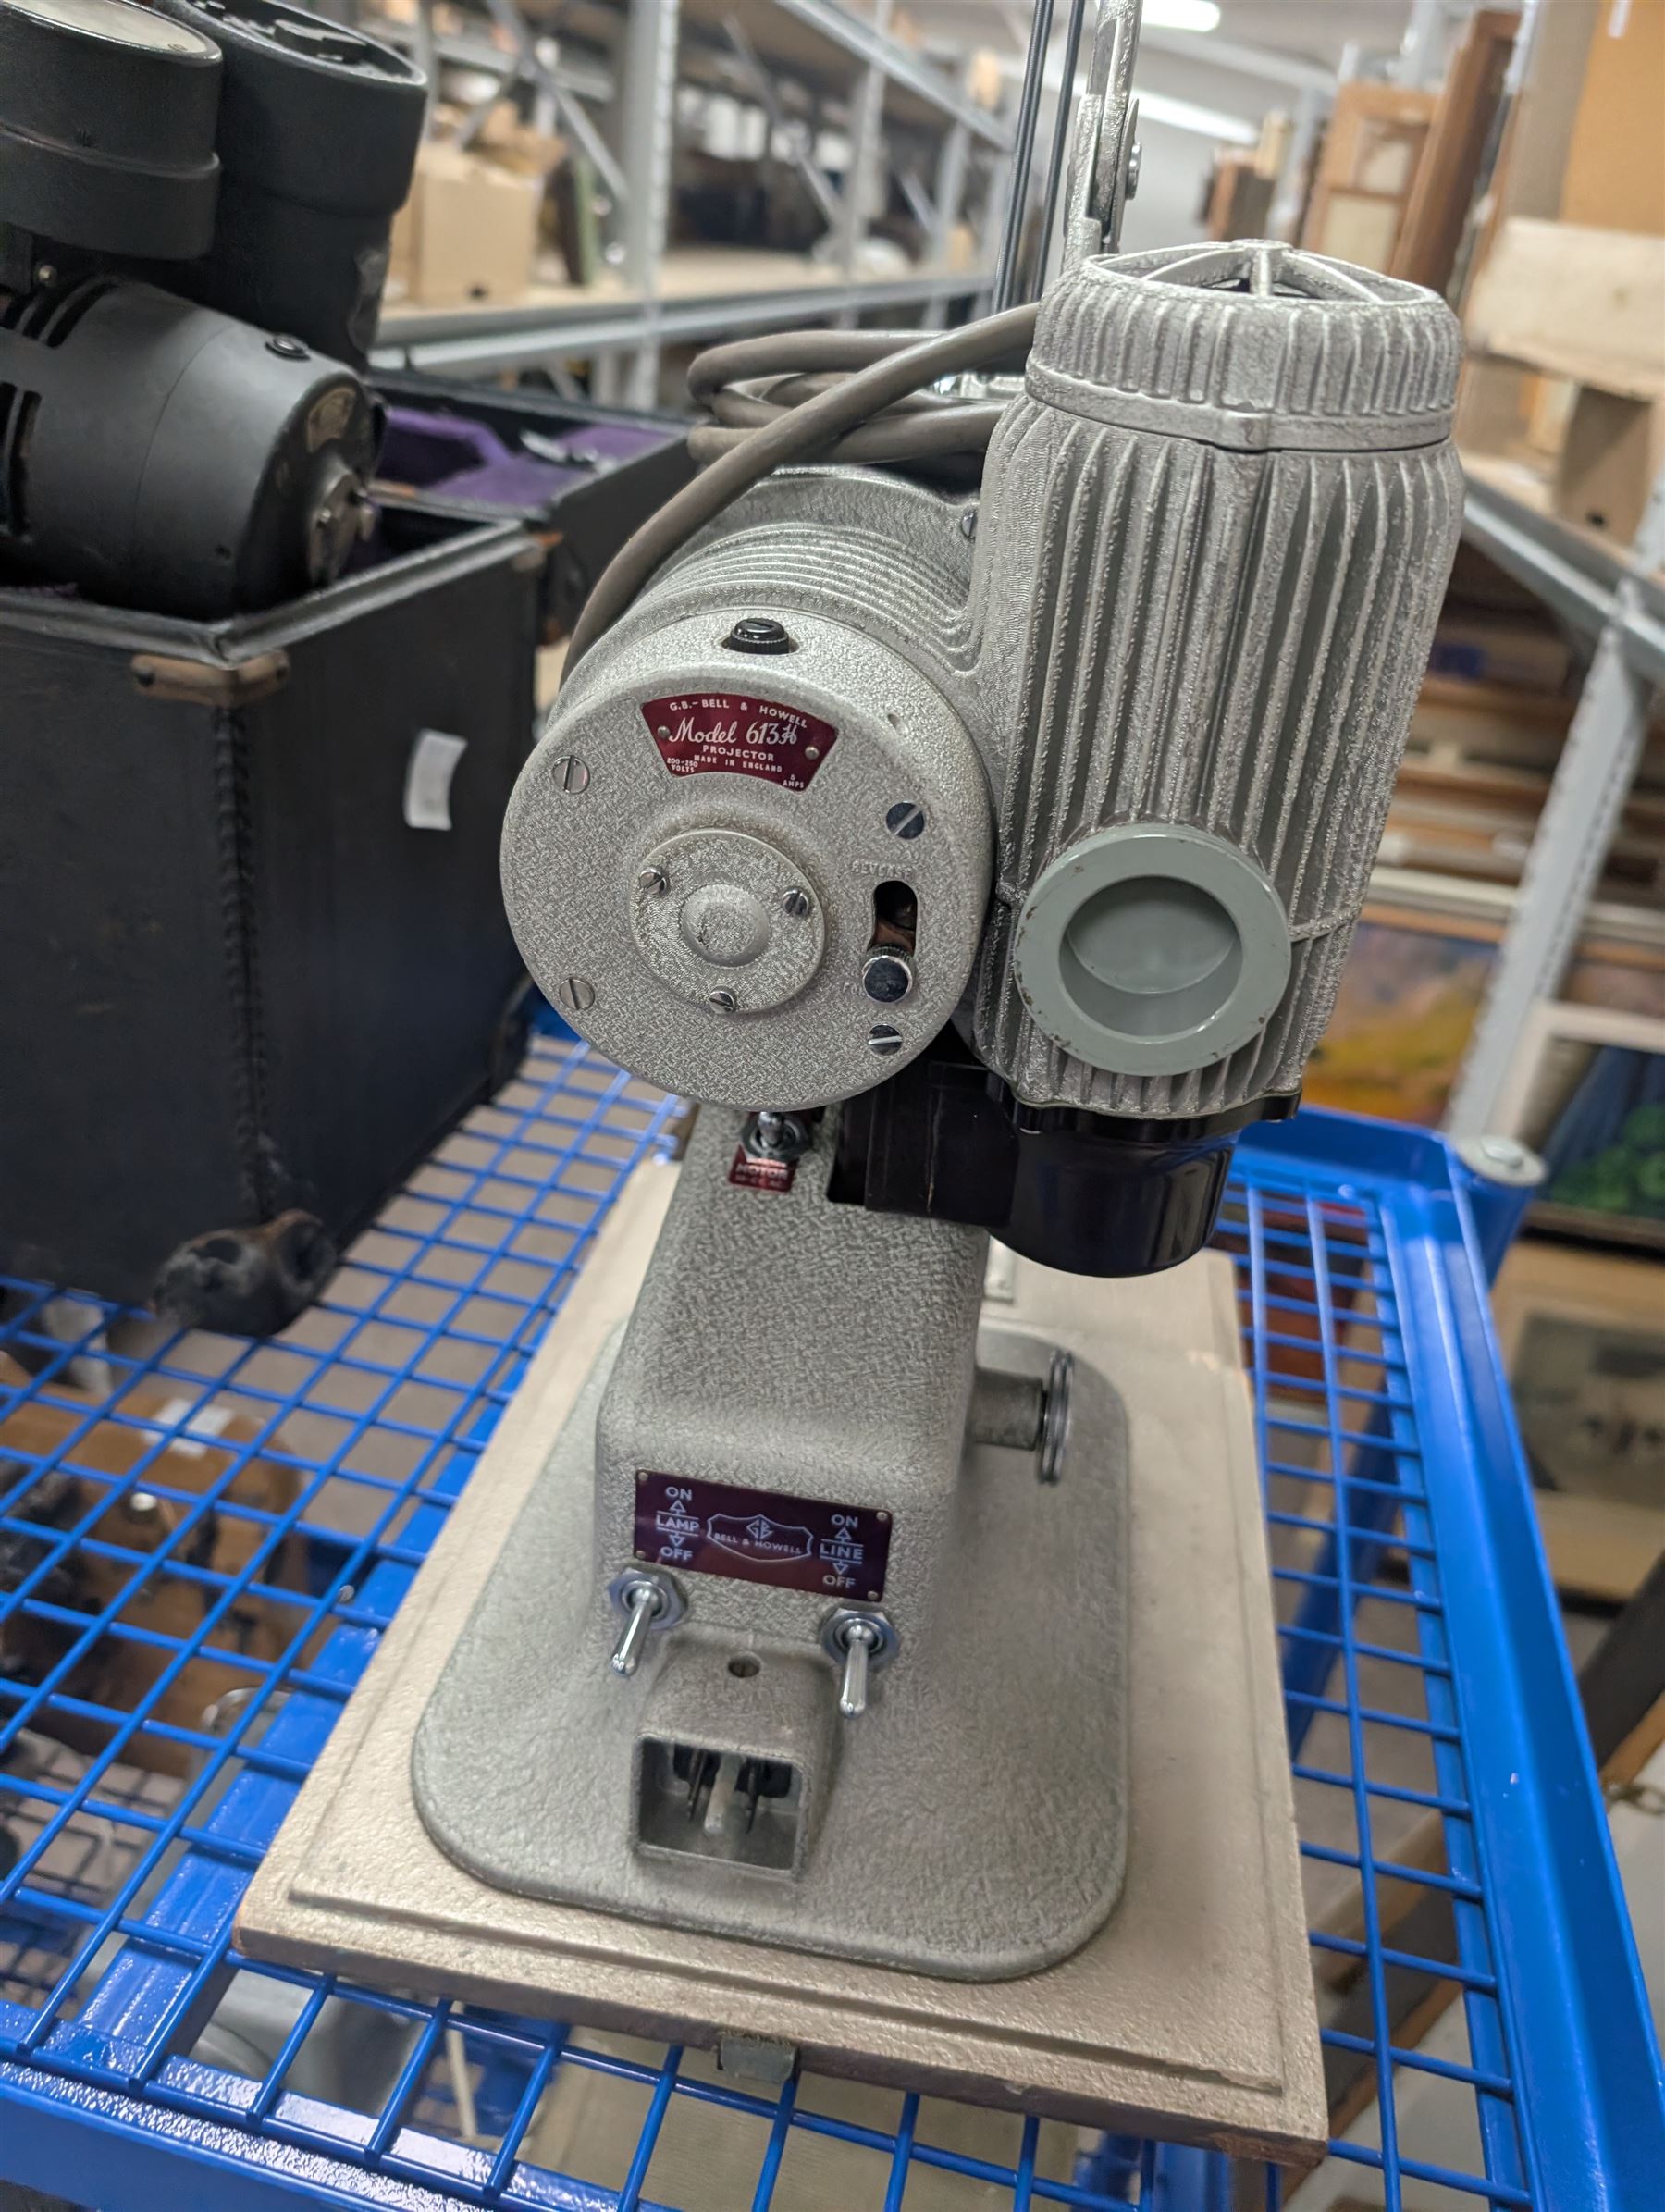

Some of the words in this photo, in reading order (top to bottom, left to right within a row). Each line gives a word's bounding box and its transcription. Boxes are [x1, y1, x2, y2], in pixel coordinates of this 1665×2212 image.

[740, 702, 747, 711] &
[759, 705, 808, 728] HOWELL
[668, 716, 738, 743] Model
[702, 745, 774, 761] PROJECTOR
[671, 764, 695, 773] VOLTS
[694, 755, 717, 764] MADE
[725, 759, 735, 767] IN
[742, 761, 783, 772] ENGLAND
[783, 779, 805, 788] AMPS
[664, 1486, 692, 1501] ON
[655, 1514, 700, 1531] LAMP
[831, 1514, 858, 1527] ON
[713, 1532, 738, 1545] BELL
[742, 1538, 750, 1546] &
[754, 1540, 802, 1555] HOWELL
[820, 1543, 864, 1560] LINE
[660, 1546, 693, 1561] OFF
[822, 1575, 857, 1589] OFF
